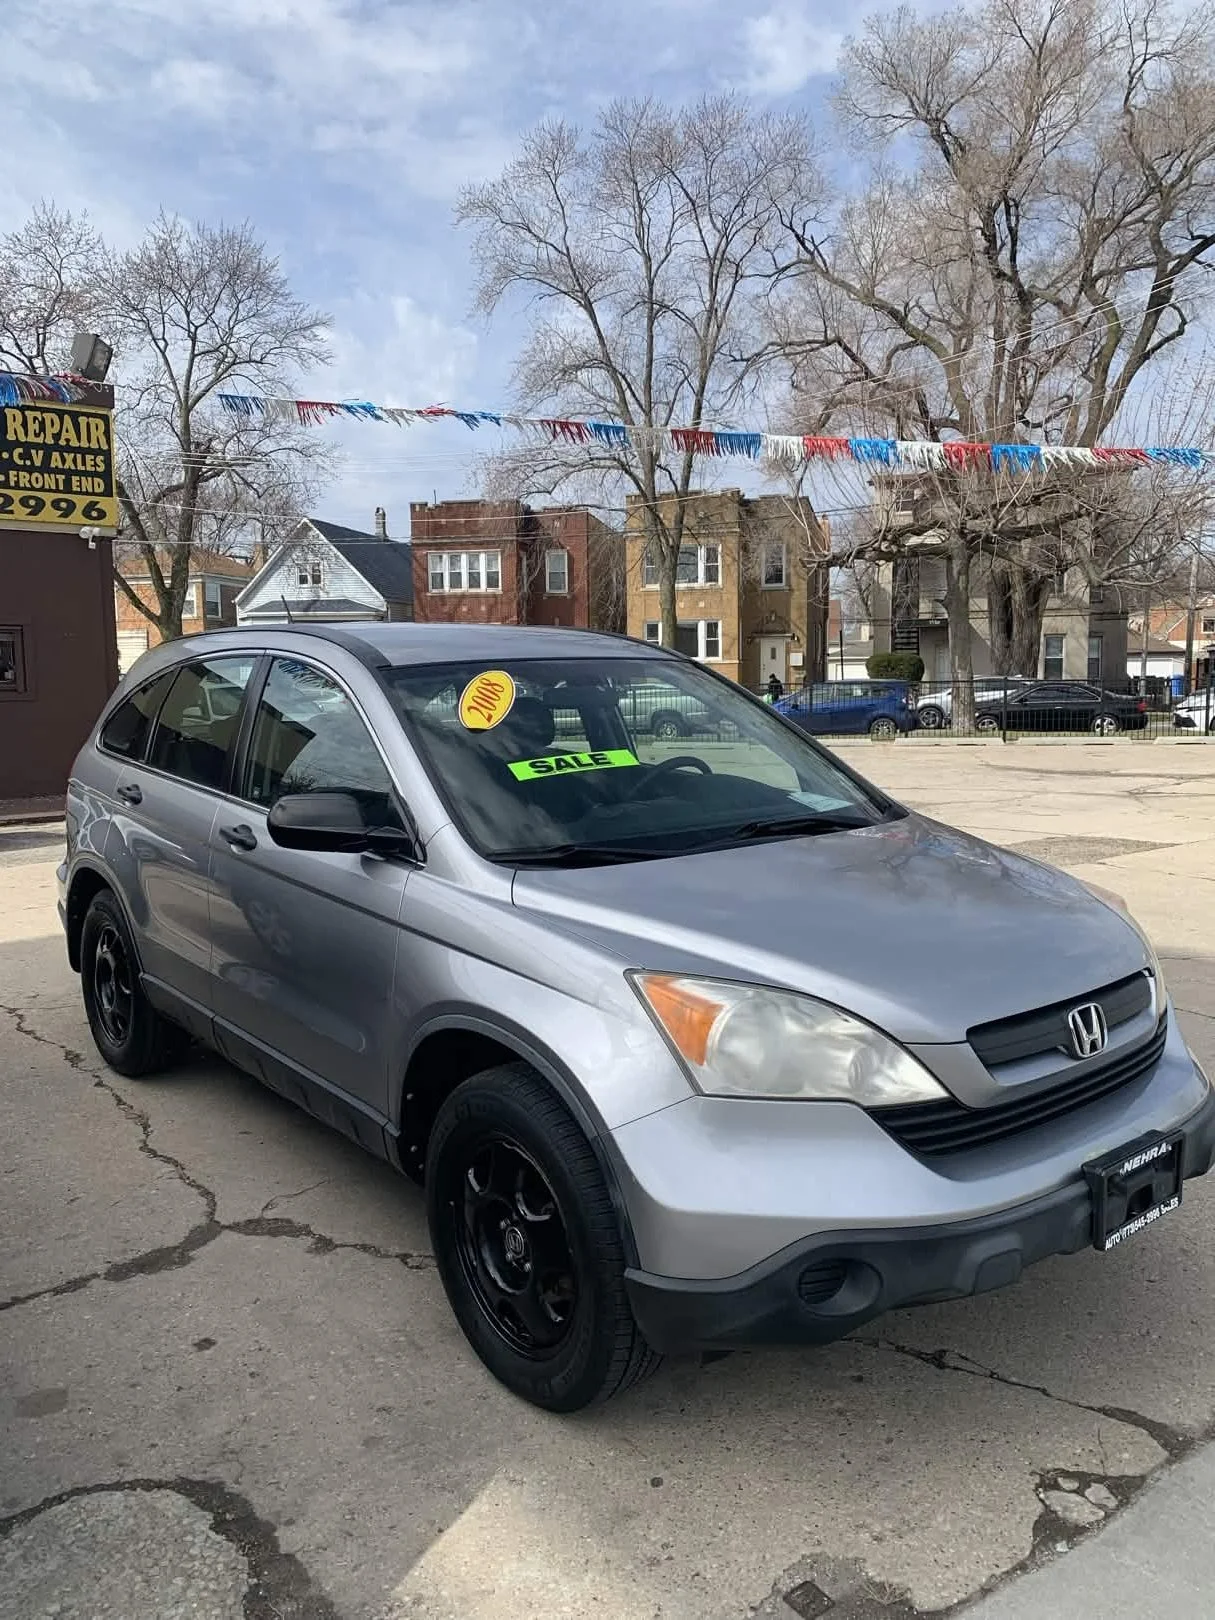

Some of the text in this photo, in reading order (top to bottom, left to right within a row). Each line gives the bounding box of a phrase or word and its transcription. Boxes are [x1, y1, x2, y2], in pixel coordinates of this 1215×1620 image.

[4, 407, 108, 450] REPAIR
[50, 451, 105, 473] AXLES
[9, 470, 105, 493] FRONT END
[467, 677, 505, 723] 2008
[528, 752, 615, 775] SALE
[1122, 1142, 1168, 1173] NEHRA
[1105, 1232, 1120, 1251] AUTO
